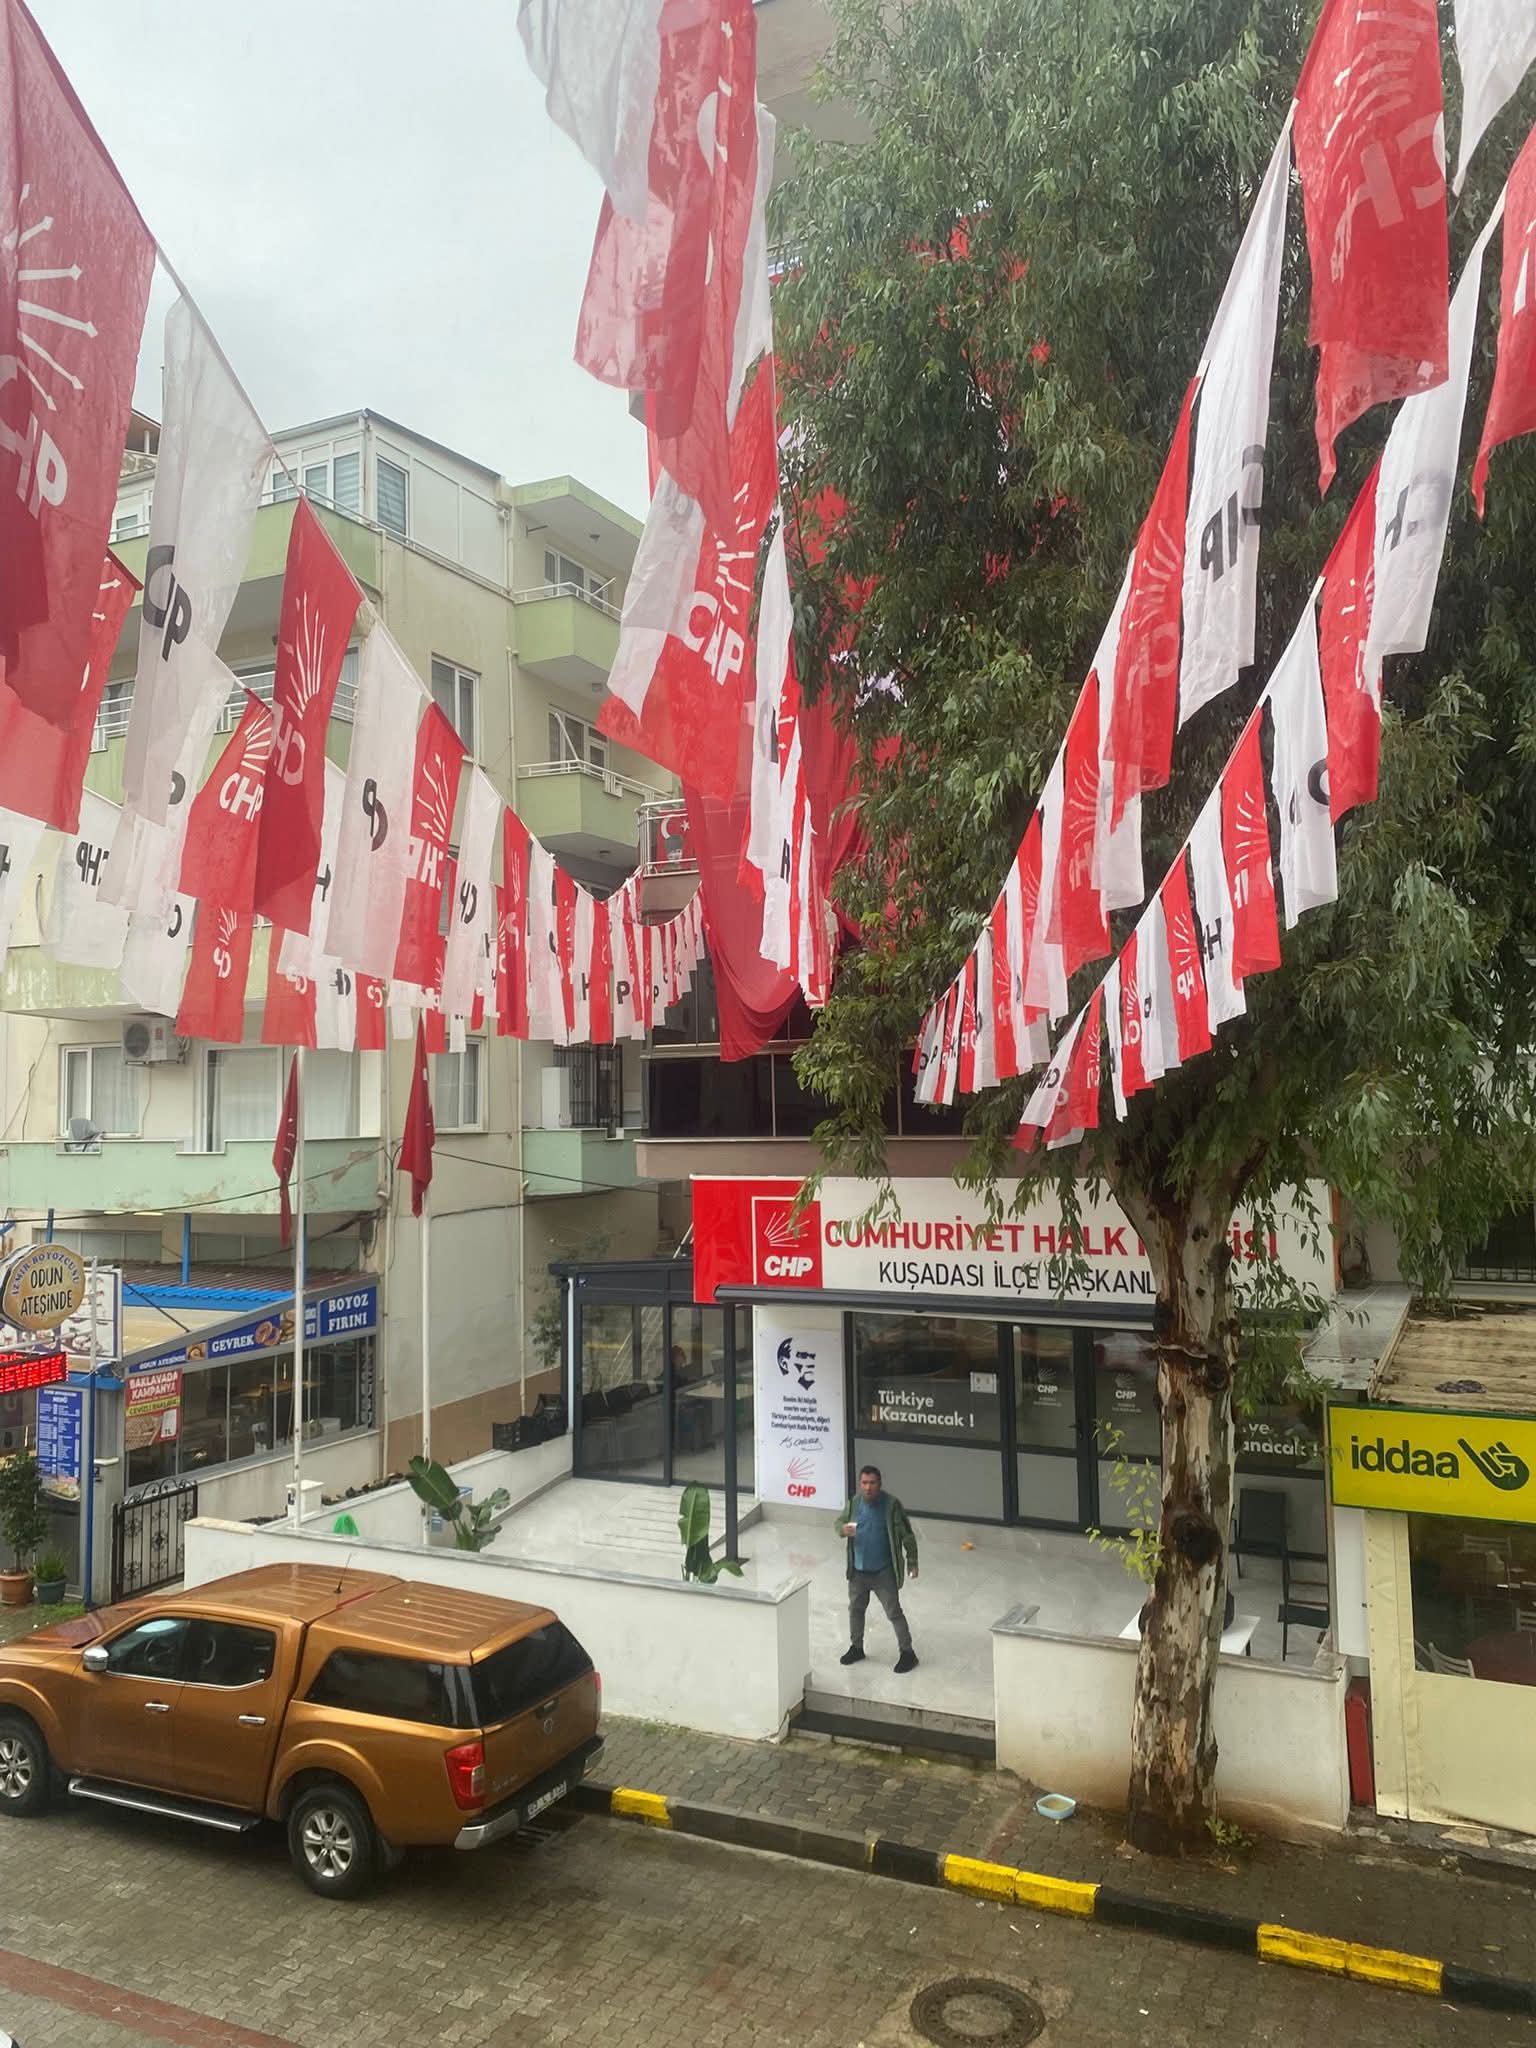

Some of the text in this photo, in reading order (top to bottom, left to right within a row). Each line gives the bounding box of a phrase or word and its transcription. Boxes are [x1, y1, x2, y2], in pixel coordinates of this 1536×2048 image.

[219, 771, 264, 823] CHP
[825, 1215, 1024, 1253] CUMHURİYET
[1034, 1225, 1128, 1256] HALK
[764, 1255, 813, 1277] CHP
[31, 1266, 63, 1289] ODUN
[879, 1260, 1157, 1298] KUŞADASI İLÇE BAŞKANL
[21, 1290, 72, 1316] ATEŞİNDE
[328, 1294, 368, 1312] BOYOZ
[328, 1313, 367, 1332] FIRINI
[212, 1334, 254, 1352] GEVREK
[129, 1371, 178, 1389] BAKLAVADA
[1037, 1384, 1058, 1394] CHP
[131, 1382, 176, 1400] KAMPANYA
[878, 1390, 934, 1410] Türkiye
[1115, 1390, 1137, 1399] CHP
[879, 1406, 964, 1427] Kazanacak
[1351, 1435, 1459, 1479] iddaa
[787, 1483, 816, 1498] CHP
